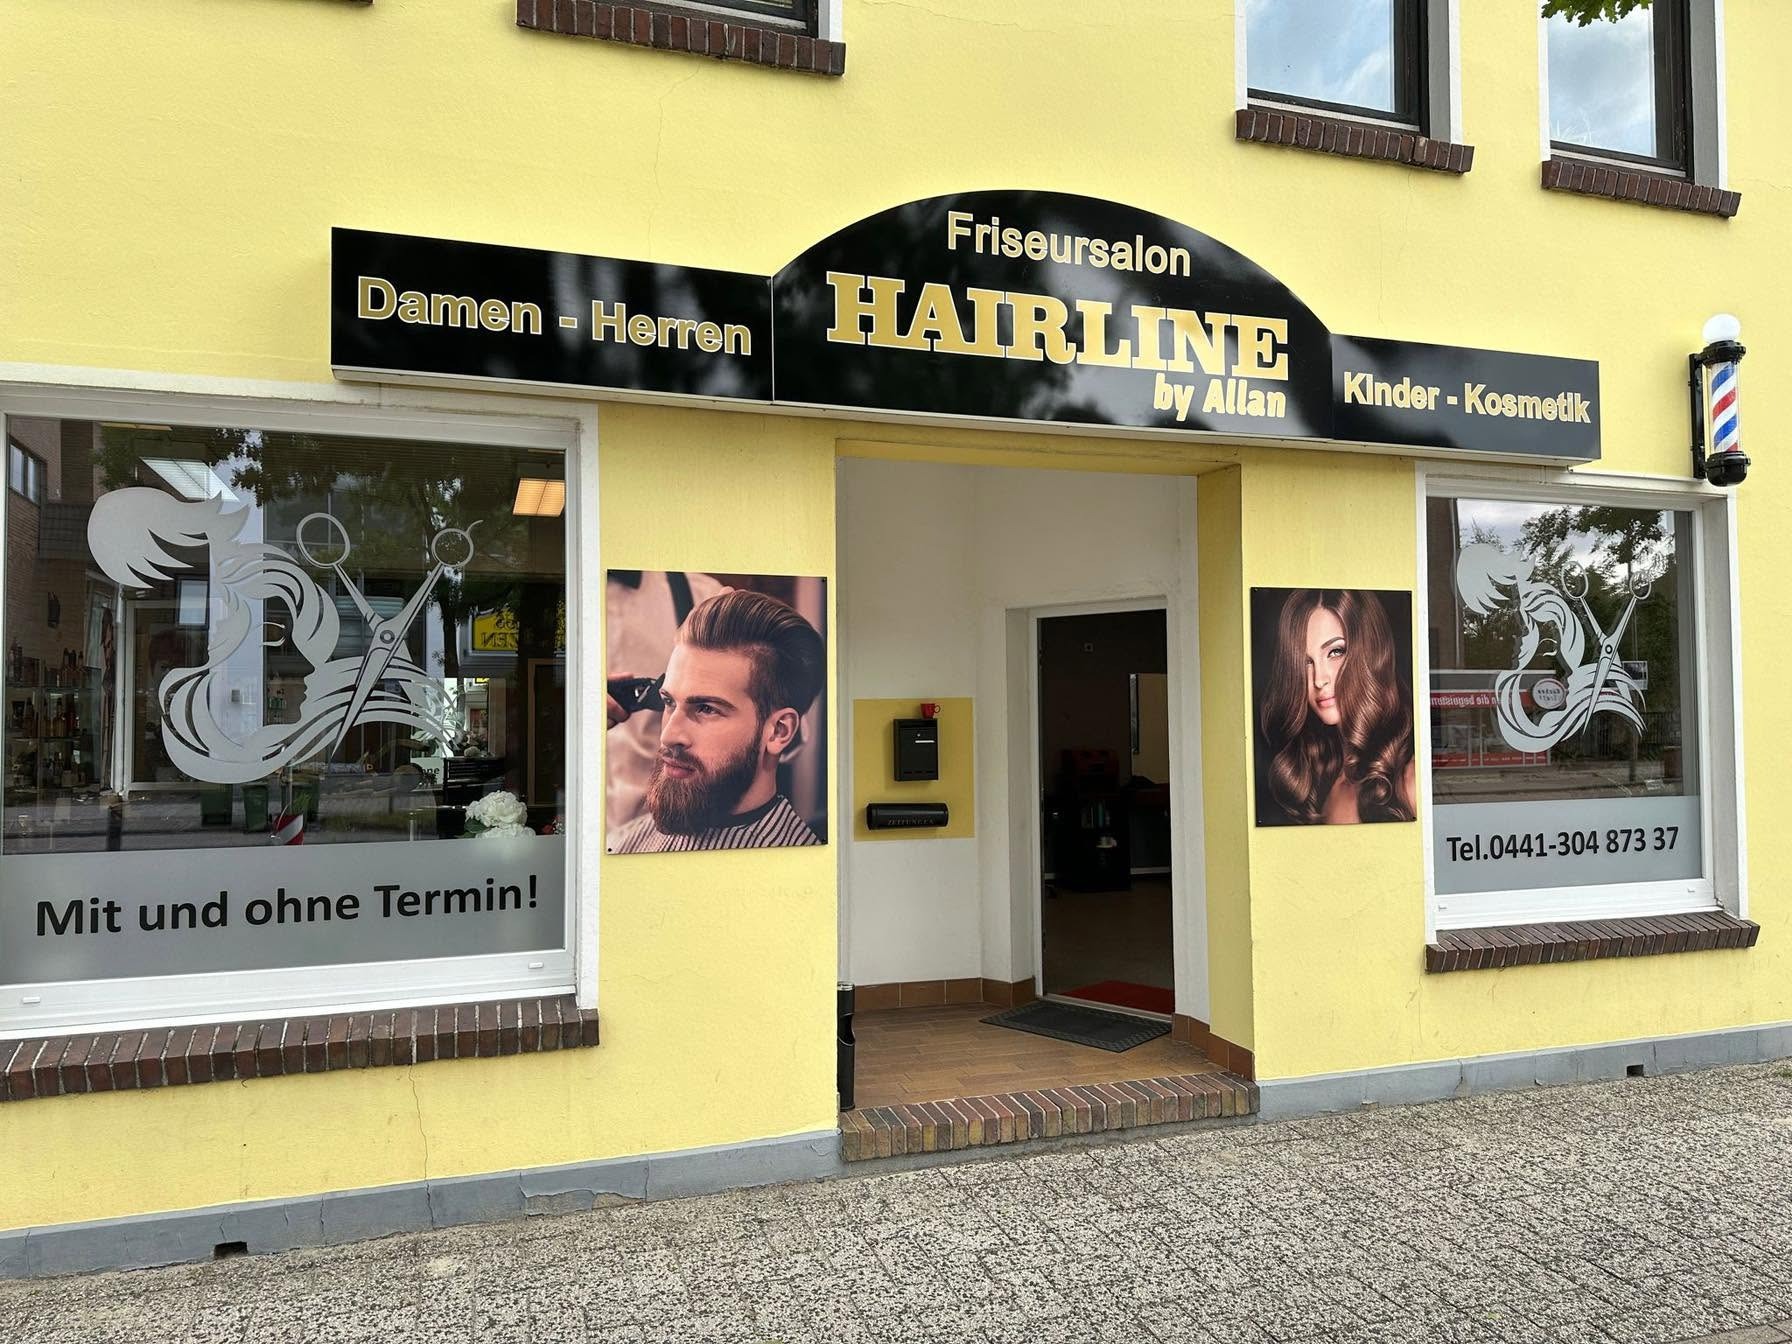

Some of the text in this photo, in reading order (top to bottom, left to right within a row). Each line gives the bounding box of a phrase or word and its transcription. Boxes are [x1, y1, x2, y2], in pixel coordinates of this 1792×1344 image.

[947, 210, 1191, 277] Friseursalon
[357, 275, 751, 355] Damen - Herren
[826, 271, 1289, 381] HAIRLINE
[1153, 373, 1287, 421] by Allan
[1343, 371, 1591, 423] Kinder - Kosmetik
[1446, 826, 1679, 862] Tel.0441-304 873 37
[36, 874, 538, 936] Mit und ohne Termin!
